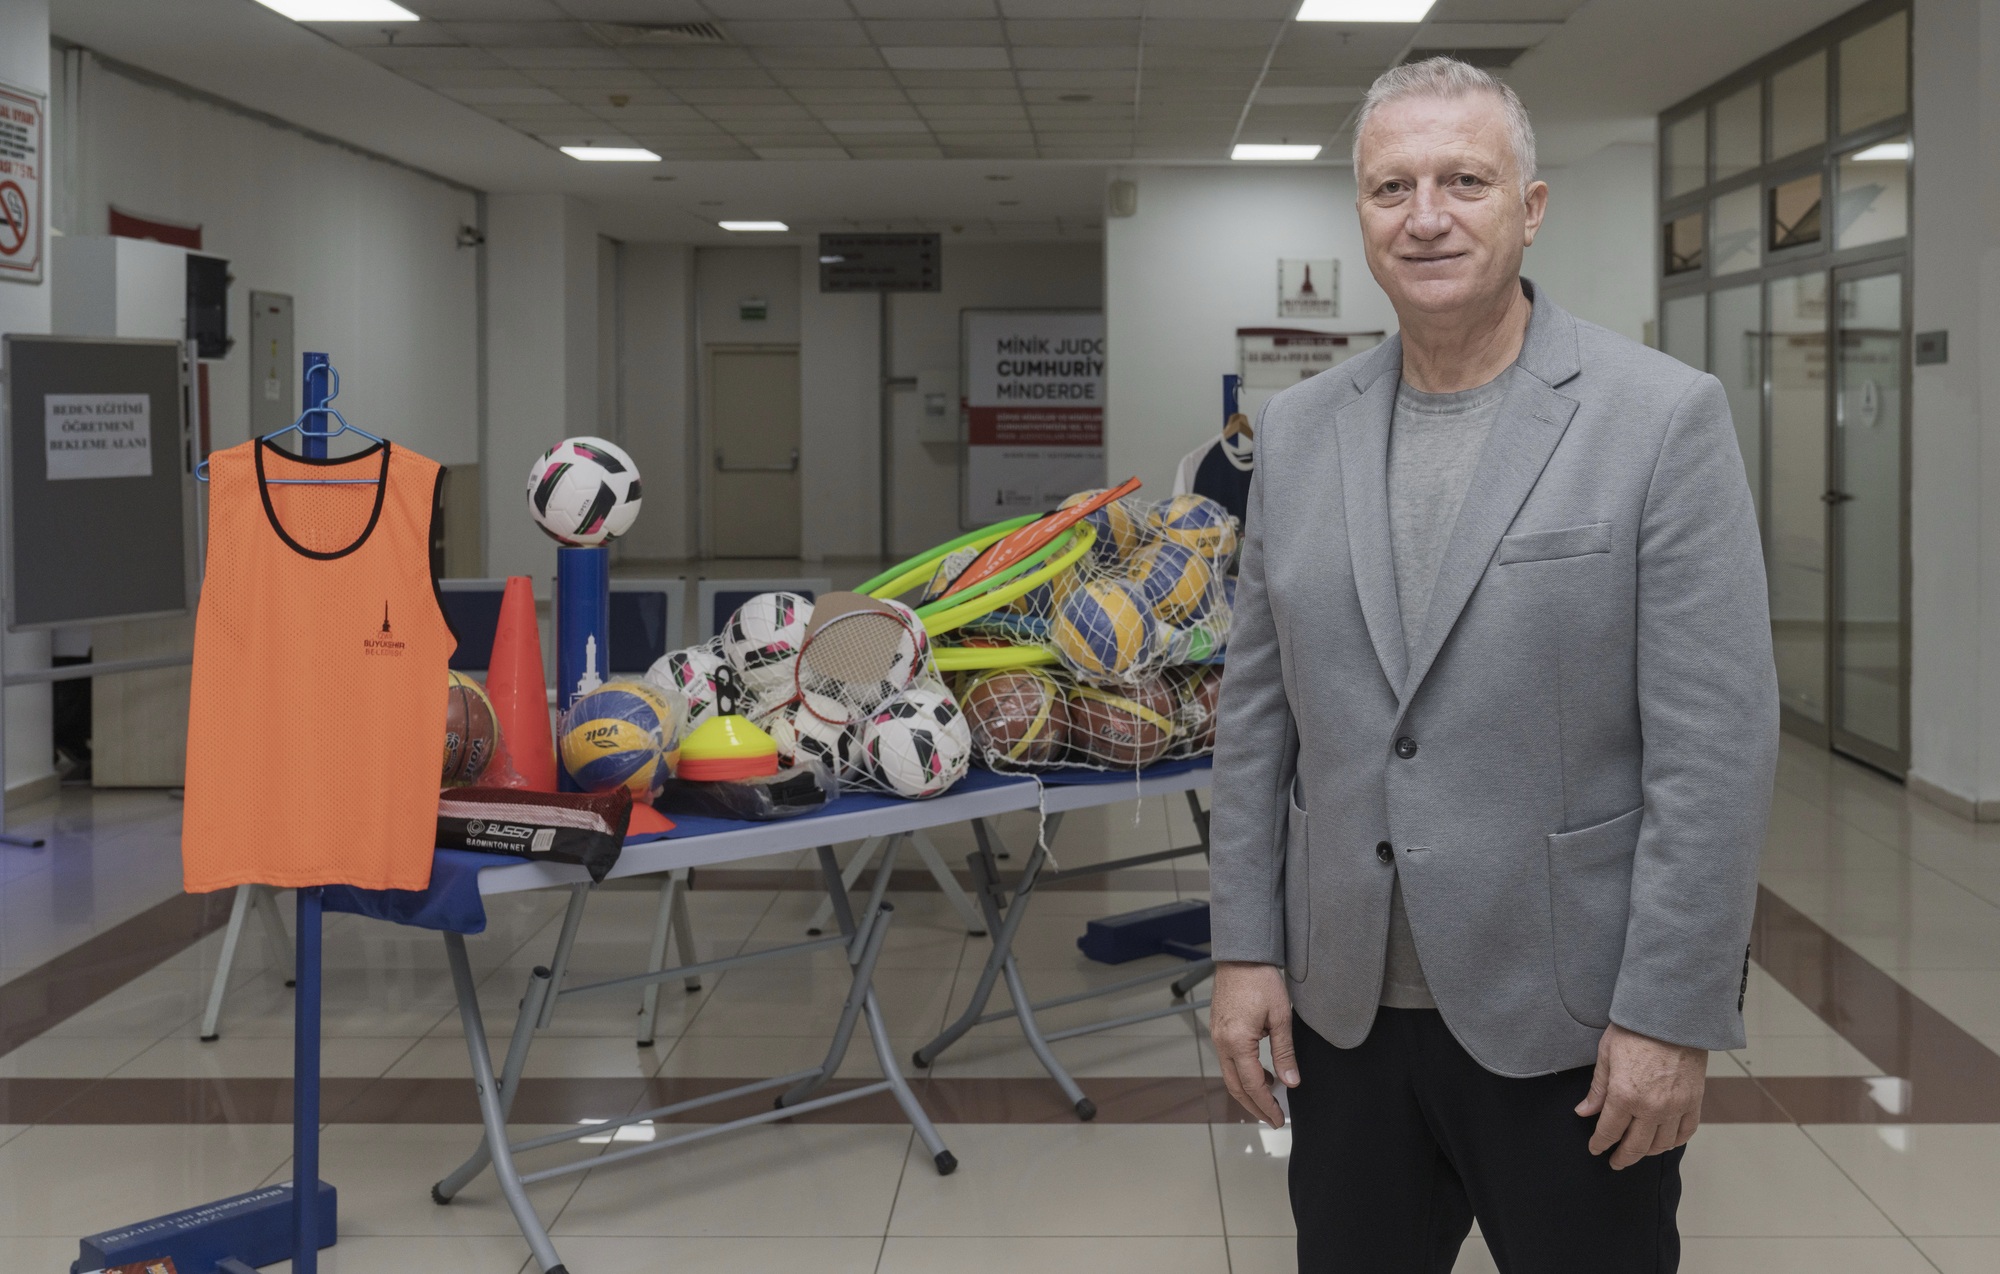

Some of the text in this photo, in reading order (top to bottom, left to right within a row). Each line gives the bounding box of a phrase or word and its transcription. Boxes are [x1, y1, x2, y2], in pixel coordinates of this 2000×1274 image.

[997, 333, 1050, 355] MİNİK
[997, 357, 1104, 377] CUMHURİY
[997, 380, 1096, 400] MİNDERDE
[53, 405, 93, 416] BEDEN
[50, 438, 147, 451] BEKLEME ALANI
[485, 823, 534, 839] BUSSO
[466, 837, 526, 852] BADMINTON NET
